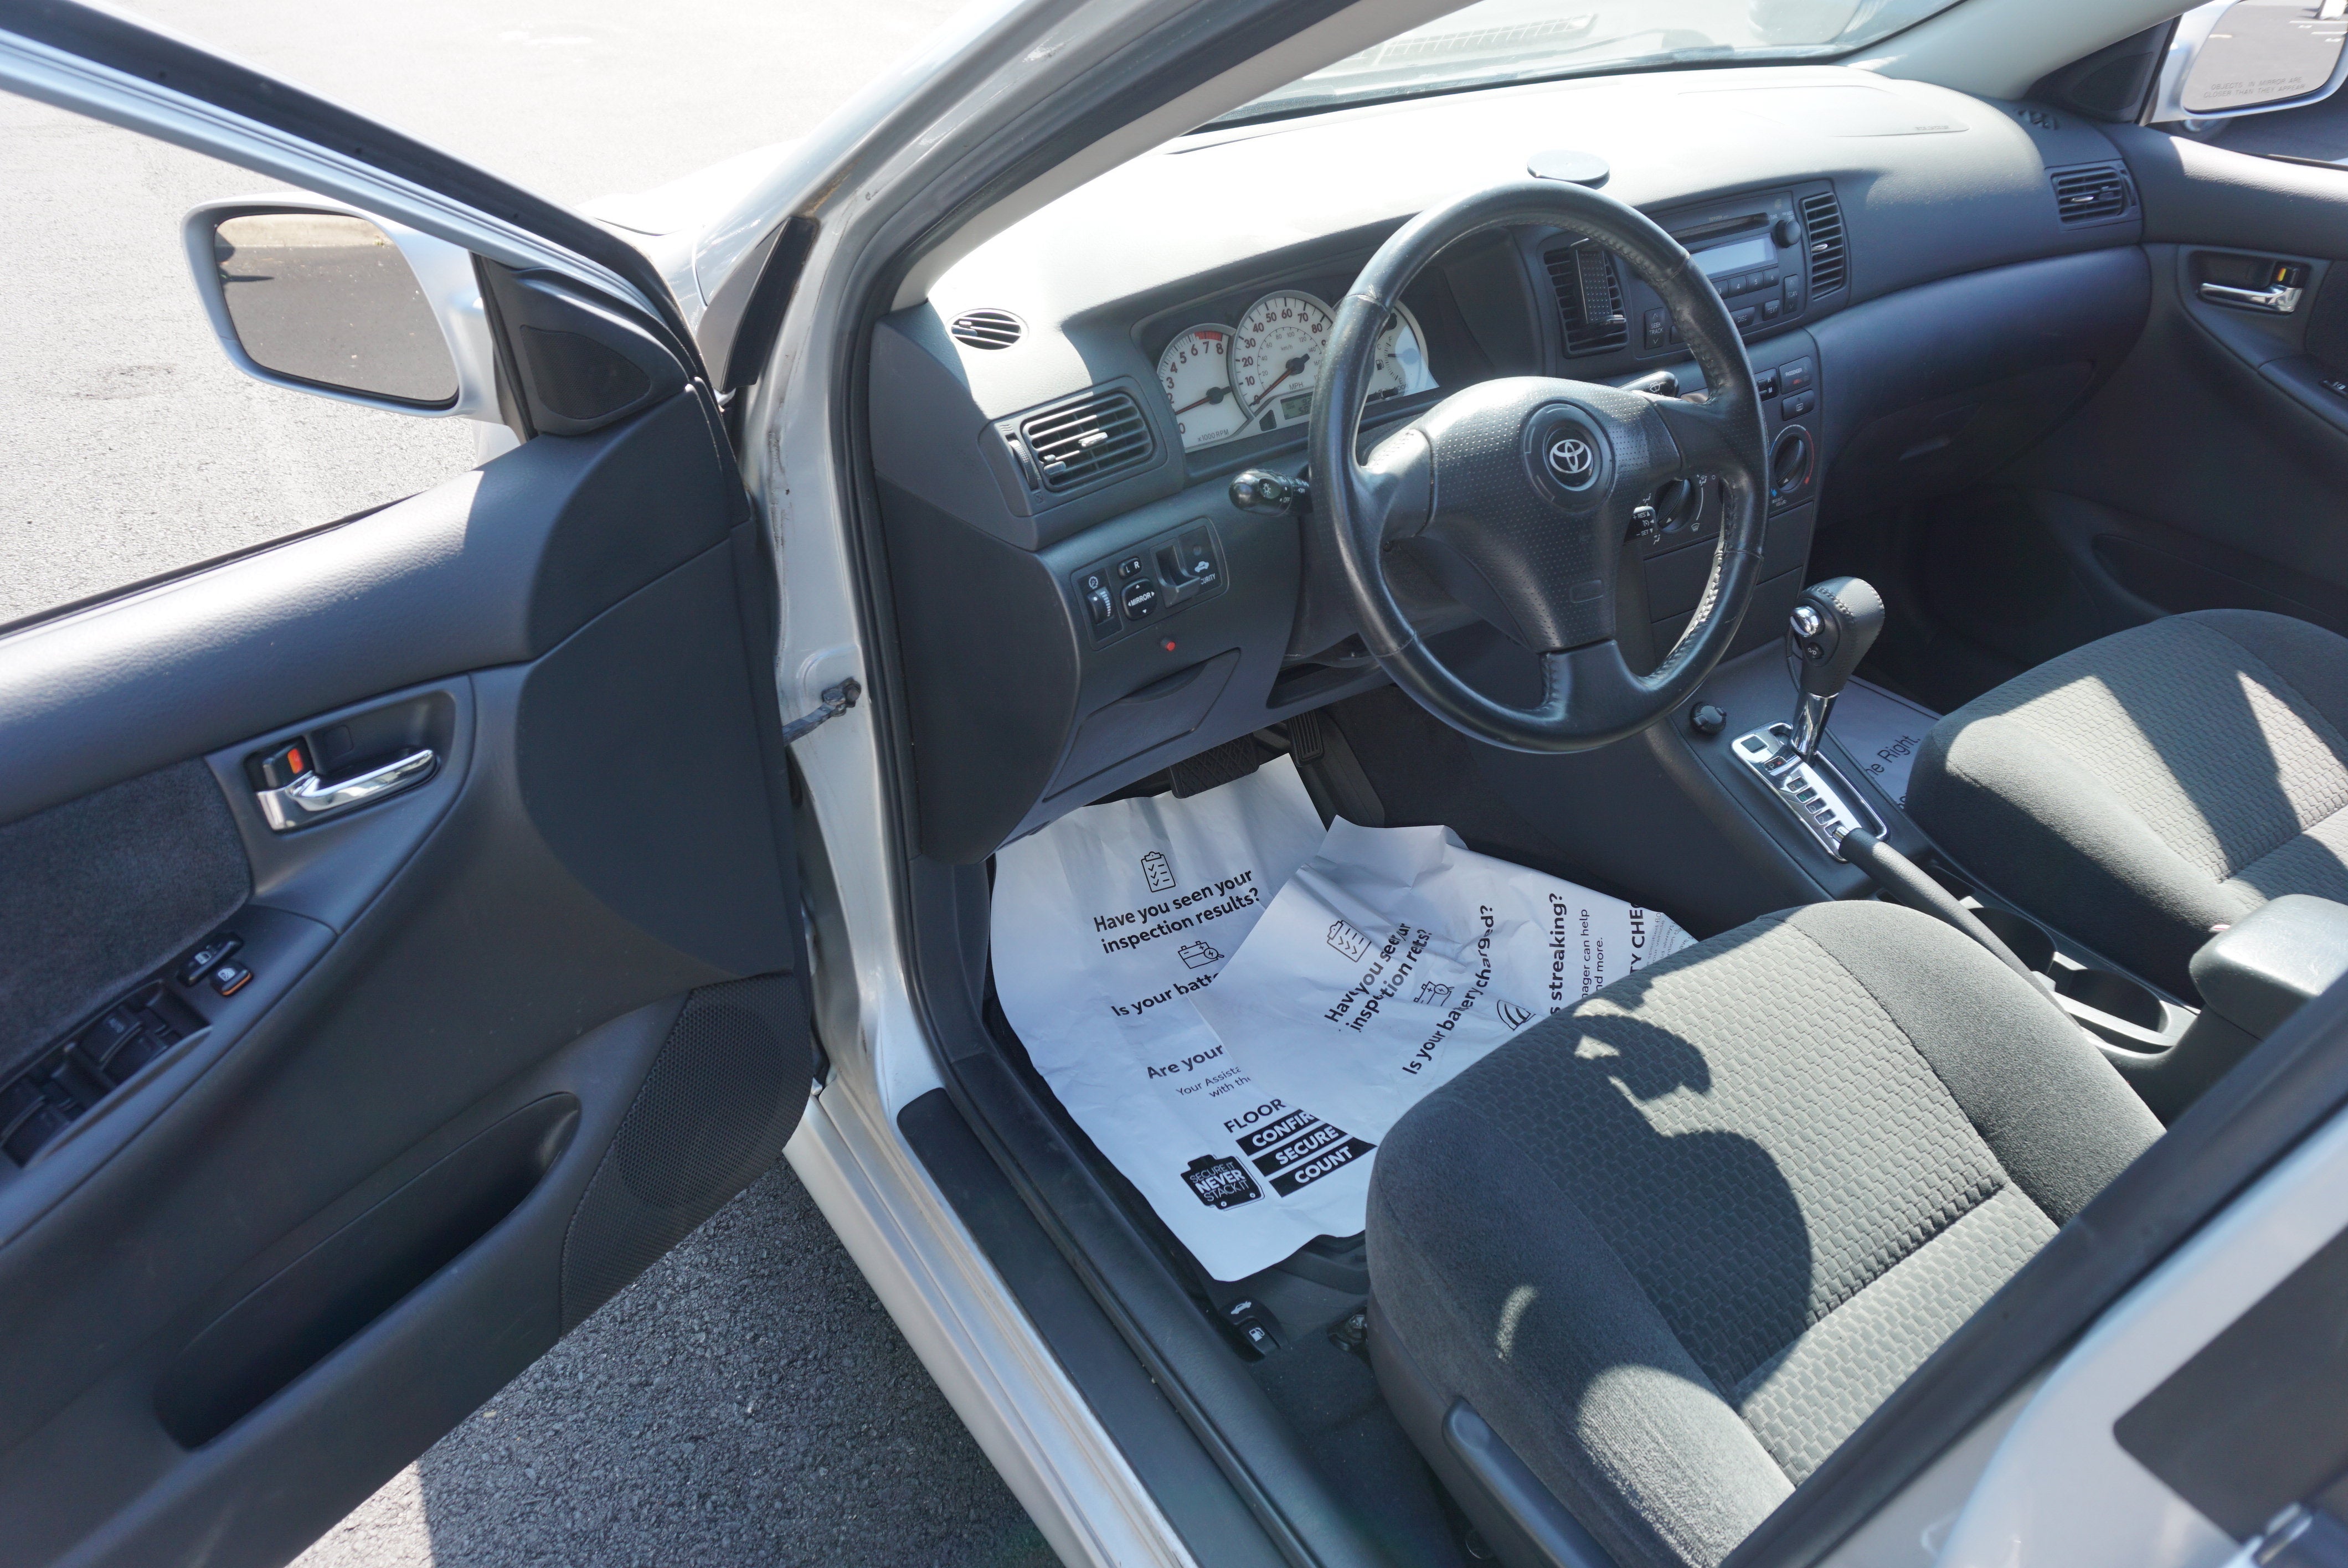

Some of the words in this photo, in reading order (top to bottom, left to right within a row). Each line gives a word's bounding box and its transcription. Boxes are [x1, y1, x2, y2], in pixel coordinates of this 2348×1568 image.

[2211, 82, 2242, 90] OBJECTS
[2259, 78, 2286, 86] MIRROR
[2235, 87, 2253, 96] THAN
[1266, 312, 1277, 323] 50
[1281, 308, 1293, 319] 60
[1297, 312, 1309, 323] 70
[1737, 314, 1748, 323] DISC
[1253, 322, 1264, 333] 40
[1311, 323, 1322, 334] 80
[1191, 344, 1198, 356] 6
[1203, 341, 1209, 354] 7
[1216, 343, 1223, 355] 8
[1244, 338, 1257, 349] 30
[1180, 351, 1187, 364] 5
[1242, 356, 1254, 368] 20
[1170, 362, 1178, 374] 4
[1166, 376, 1175, 389] 3
[1245, 376, 1255, 386] 10
[1289, 382, 1304, 391] MPH
[1166, 392, 1175, 404] 2
[1178, 422, 1186, 434] 0
[1197, 432, 1216, 442] x1000
[1216, 429, 1229, 438] RPM
[1125, 565, 1130, 574] L
[1134, 560, 1140, 570] R
[1200, 572, 1216, 585] CURITY
[1131, 591, 1152, 607] MIRROR
[1808, 647, 1817, 656] O/D
[1877, 735, 1921, 764] Right.
[1093, 912, 1136, 932] Have
[1137, 902, 1171, 924] you
[1172, 886, 1214, 910] seen
[1214, 870, 1253, 896] your
[1101, 917, 1195, 954] inspection
[1195, 887, 1260, 924] results?
[1579, 909, 1590, 936] help
[1629, 902, 1645, 948] CHE
[1549, 893, 1567, 1001] streaking?
[1595, 937, 1604, 972] more.
[1355, 961, 1384, 995] you
[1402, 1060, 1422, 1075] Is
[1415, 1030, 1446, 1061] your
[1475, 905, 1495, 988] charged?
[1111, 1005, 1130, 1017] Is
[1130, 989, 1172, 1015] your
[1147, 1063, 1180, 1079] Are
[1181, 1044, 1224, 1071] your
[1176, 1082, 1202, 1096] Your
[1209, 1083, 1234, 1098] with
[1223, 1098, 1287, 1133] FLOOR
[1275, 1126, 1340, 1165] SECURE
[1295, 1146, 1353, 1184] COUNT
[1190, 1164, 1228, 1184] SECURE
[1226, 1161, 1235, 1172] IT
[1194, 1169, 1246, 1194] NEVER
[1203, 1183, 1242, 1202] STACK
[1238, 1179, 1249, 1190] IT
